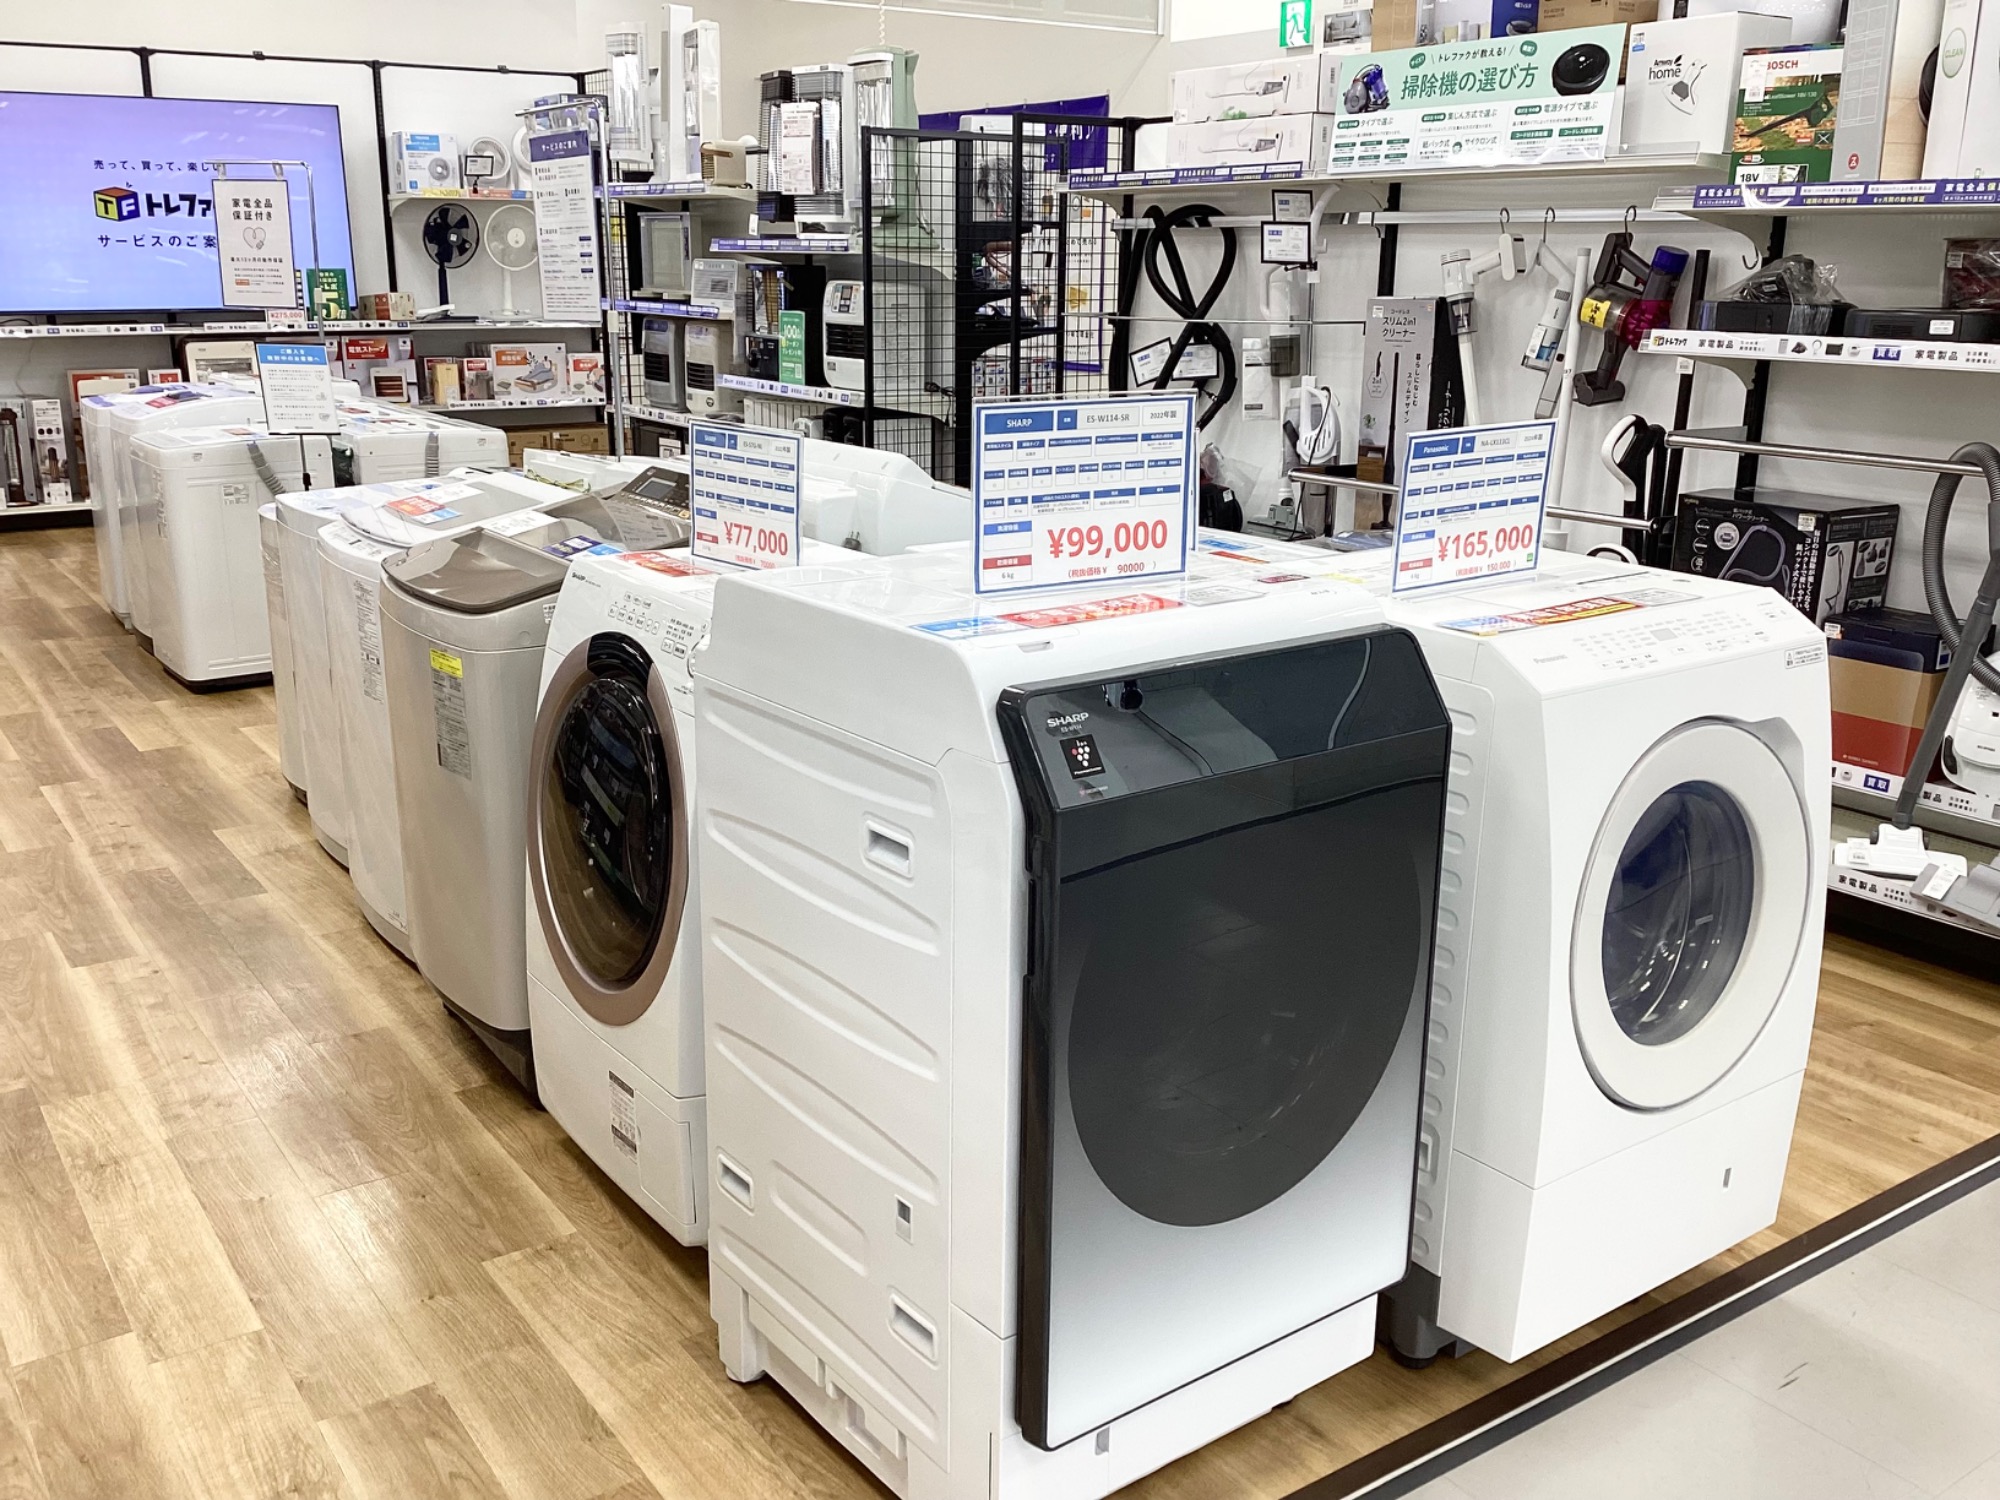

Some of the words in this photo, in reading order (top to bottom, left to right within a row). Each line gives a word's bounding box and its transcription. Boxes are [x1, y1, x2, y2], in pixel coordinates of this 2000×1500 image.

[1648, 66, 1682, 80] home
[1400, 62, 1539, 100] 掃除機の選び方
[1543, 101, 1599, 114] 電源タイプで選ぶ
[1360, 117, 1394, 127] タイプで選ぶ
[1739, 173, 1760, 183] 18V
[1382, 328, 1417, 338] クリーナー
[1915, 350, 1958, 361] 家電製品
[1006, 418, 1033, 428] SHARP
[1086, 413, 1130, 424] ES-W114-SR
[1423, 443, 1450, 454] Panasonic
[724, 521, 789, 557] ¥77,000
[1047, 519, 1168, 559] ¥99,000
[1437, 524, 1534, 562] ¥165,000
[1117, 562, 1145, 575] 90000
[1046, 712, 1090, 728] SHARP
[1866, 776, 1888, 791] 買取
[1838, 874, 1878, 894] 家電製品
